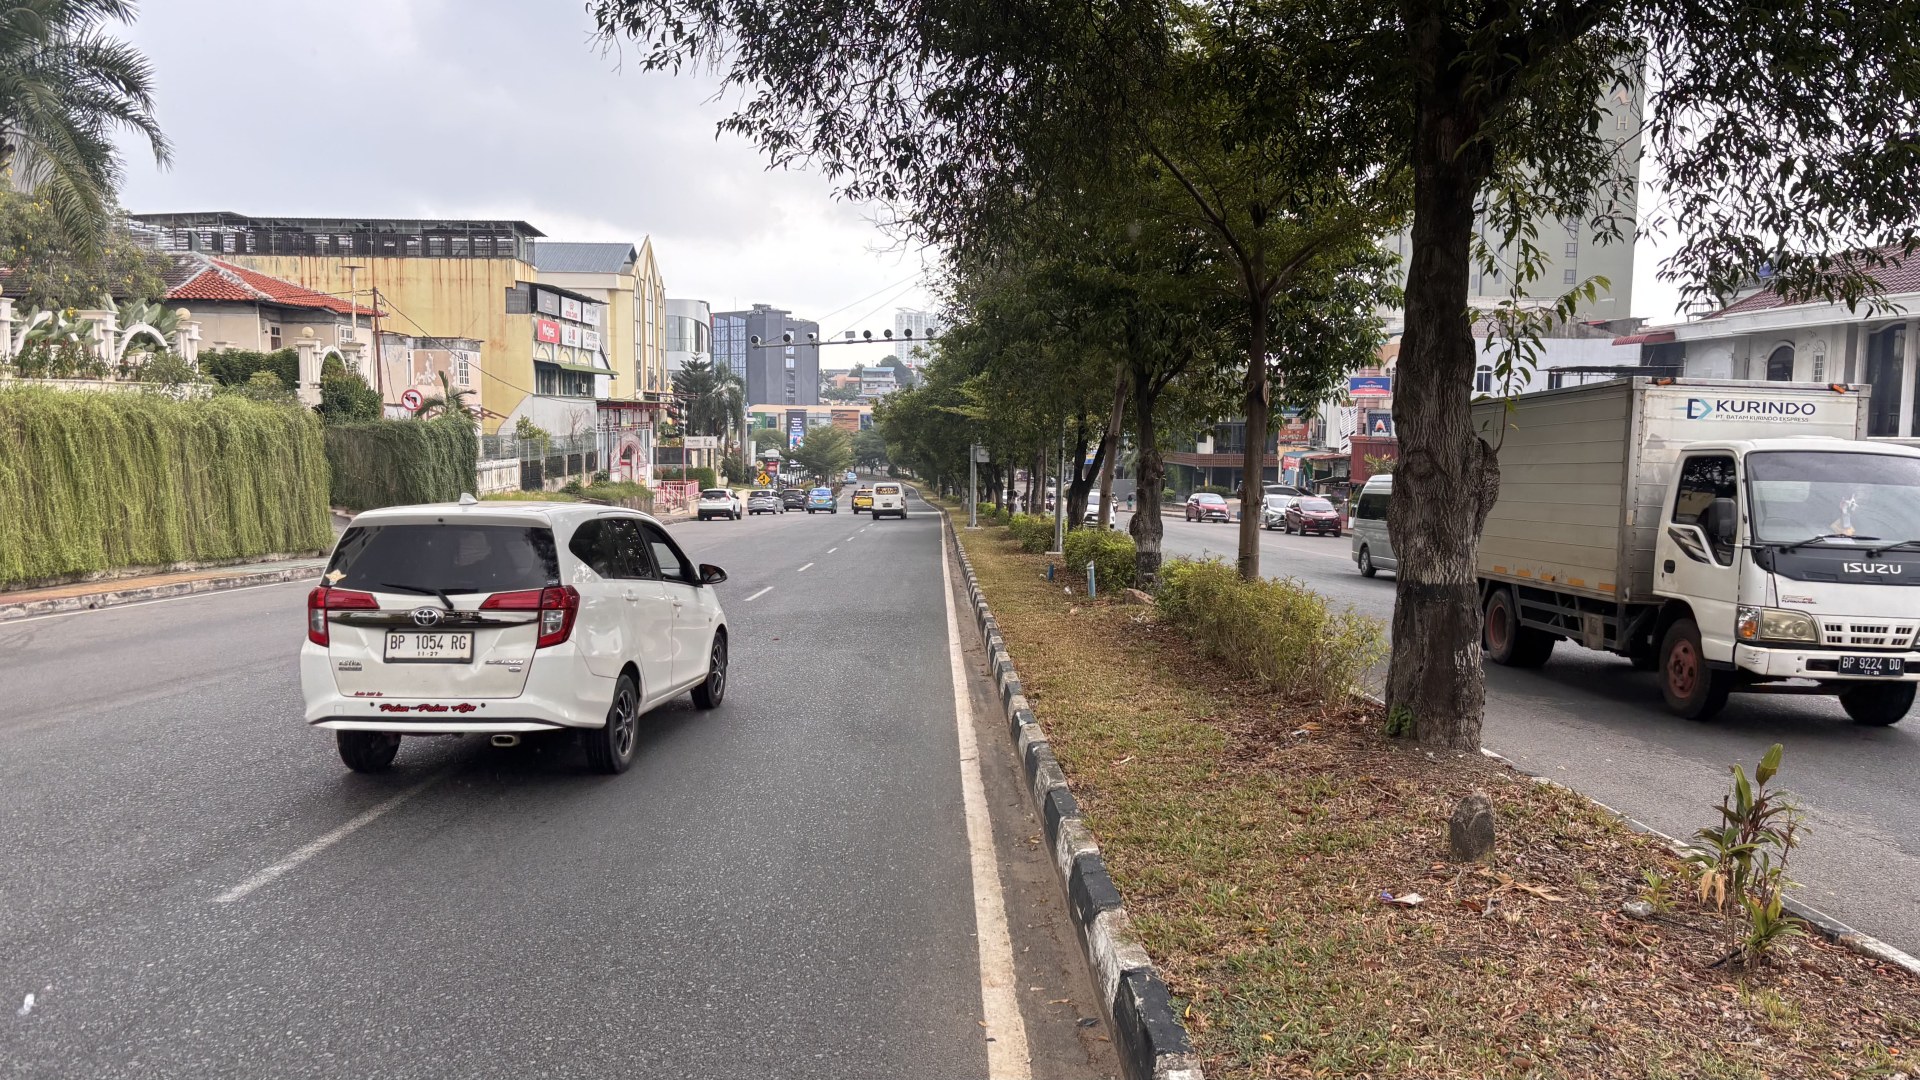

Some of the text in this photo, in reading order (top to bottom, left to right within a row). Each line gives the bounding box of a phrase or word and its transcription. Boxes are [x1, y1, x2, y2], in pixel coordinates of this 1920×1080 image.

[1612, 115, 1629, 210] HOL
[1716, 399, 1816, 415] KURINDO
[1843, 562, 1902, 575] ISUZU
[390, 634, 467, 650] BP 1054 RG
[1842, 656, 1901, 671] BP 9224 DD
